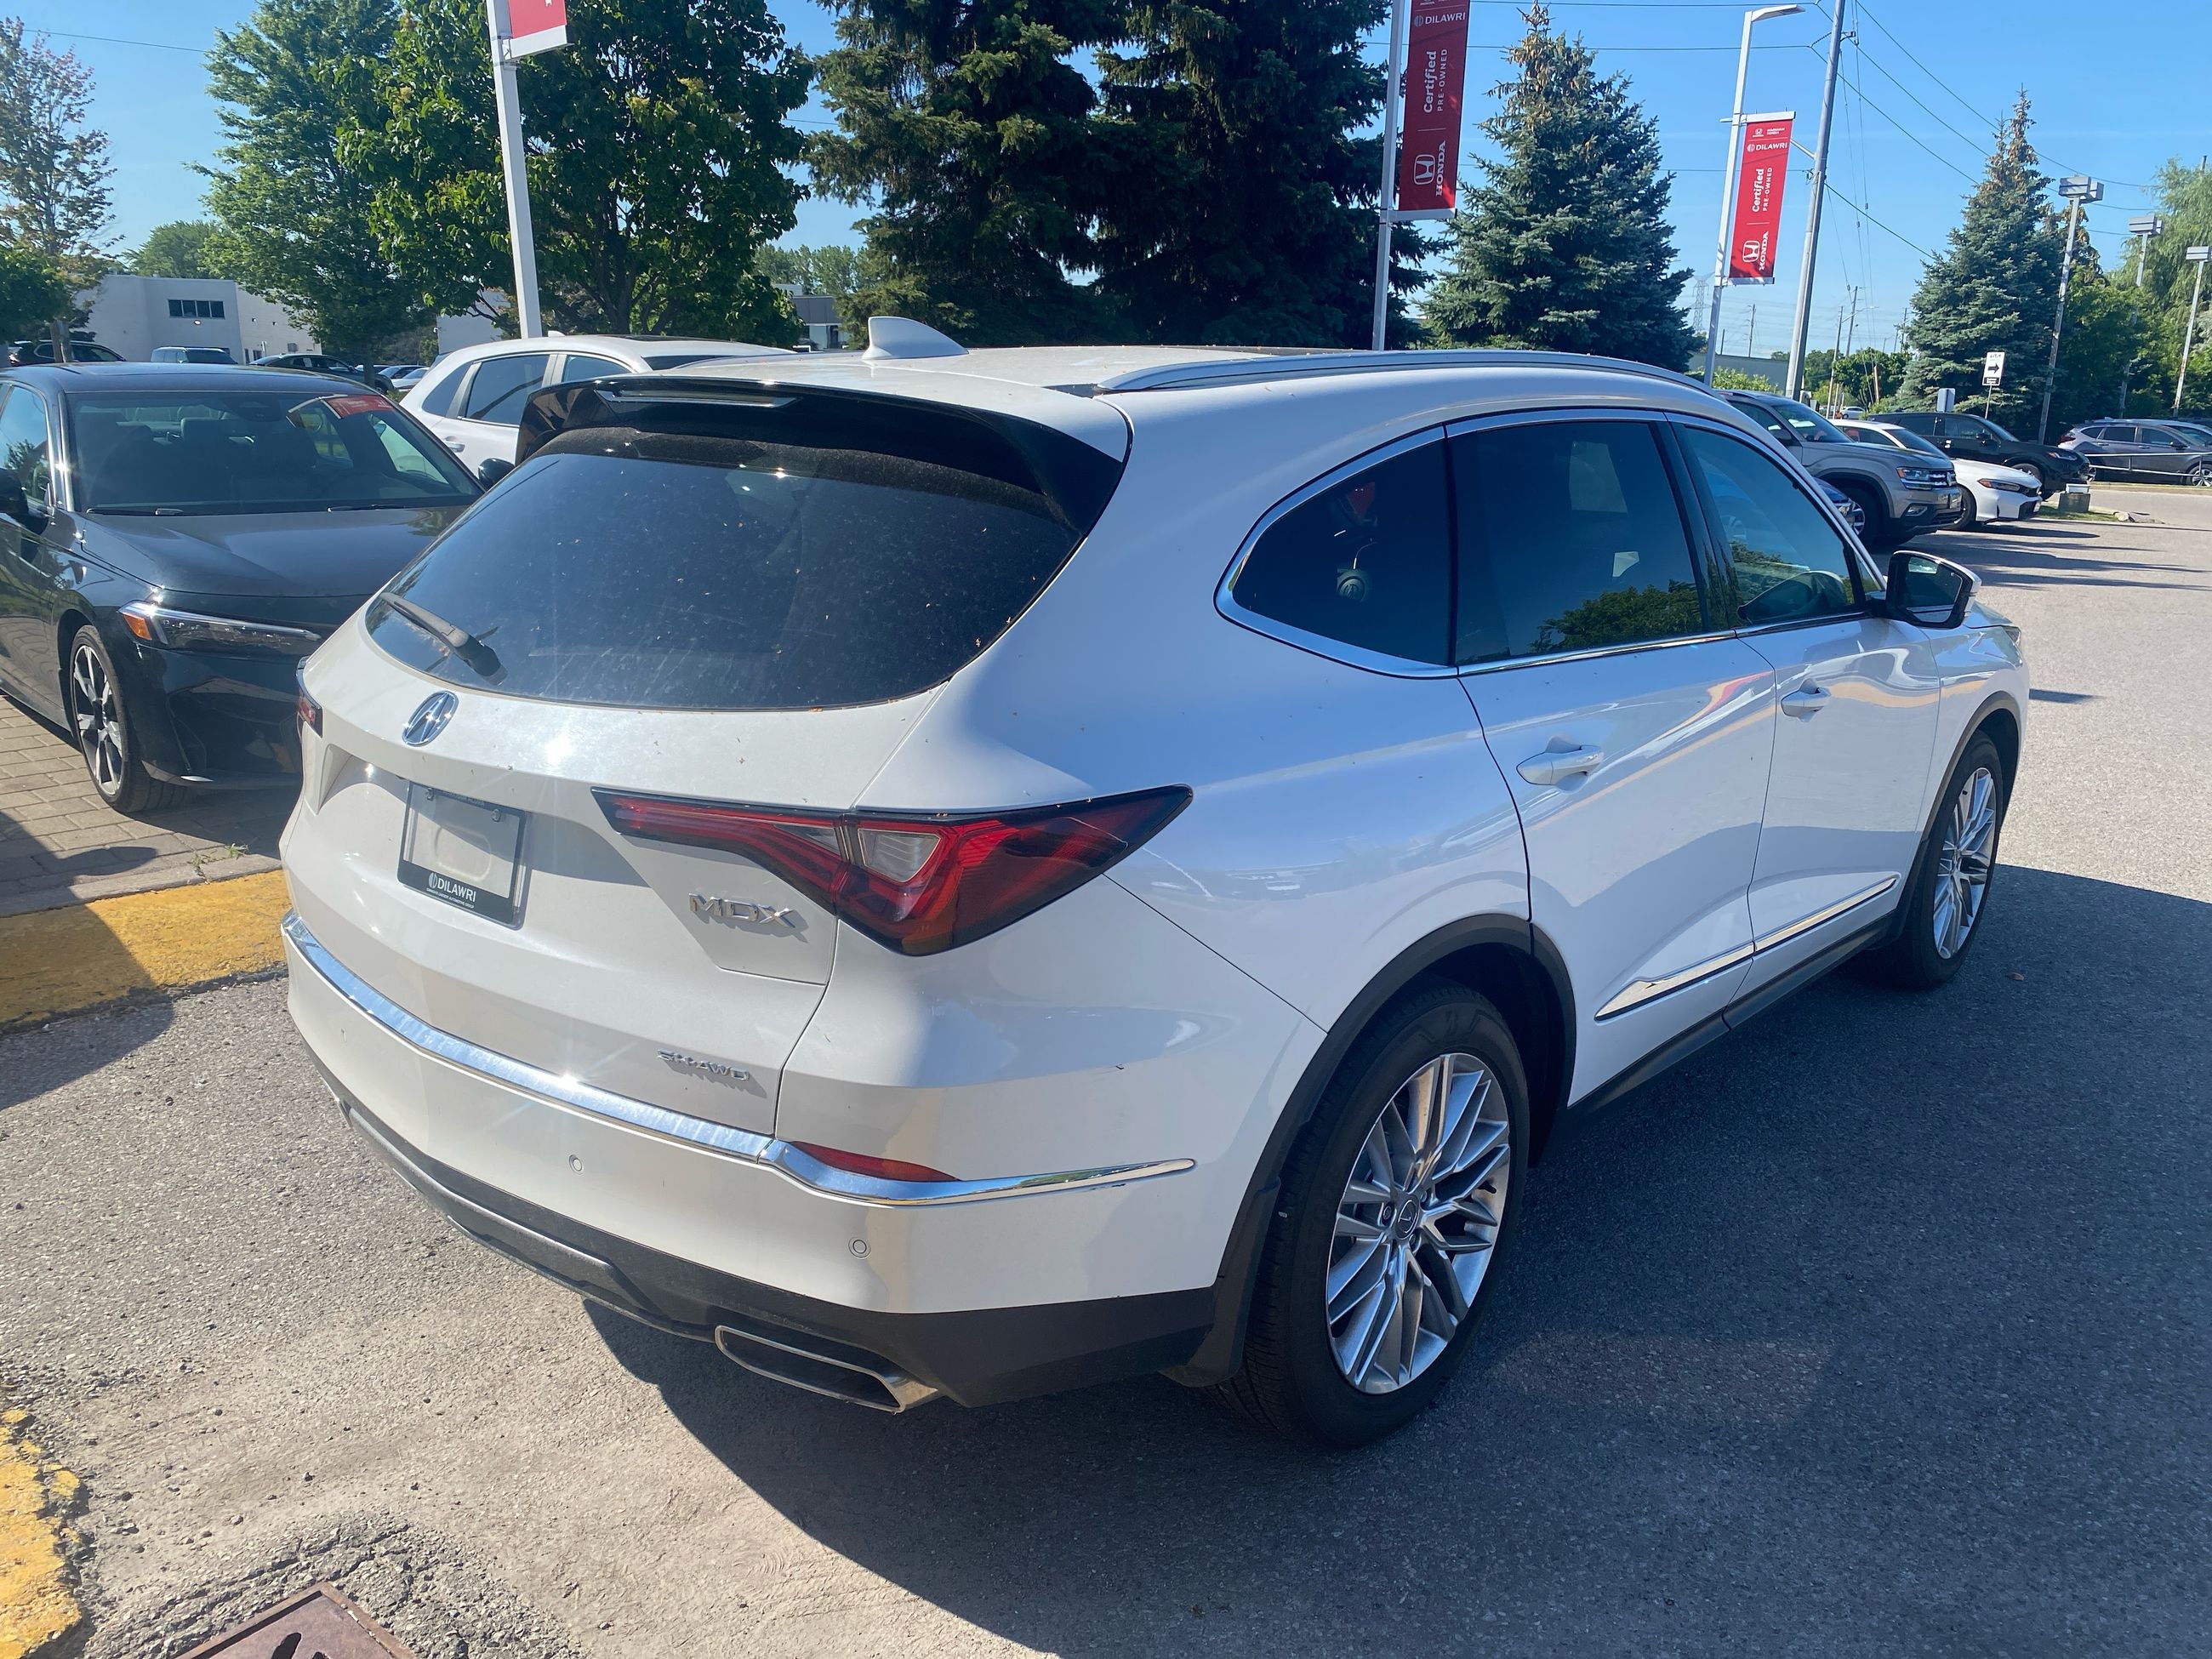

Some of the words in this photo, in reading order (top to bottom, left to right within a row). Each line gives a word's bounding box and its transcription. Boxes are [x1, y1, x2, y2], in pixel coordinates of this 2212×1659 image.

[1425, 12, 1466, 25] DILAWRI
[1423, 50, 1437, 113] Certified
[1437, 48, 1448, 111] PRE-OWNED
[1756, 142, 1787, 151] DILAWRI
[1436, 140, 1446, 197] HONDA
[1762, 167, 1773, 212] PRE-OWNED
[1752, 168, 1764, 213] Certified
[1759, 231, 1769, 271] HONDA
[437, 877, 476, 903] DILAWRI
[688, 892, 795, 928] MDX
